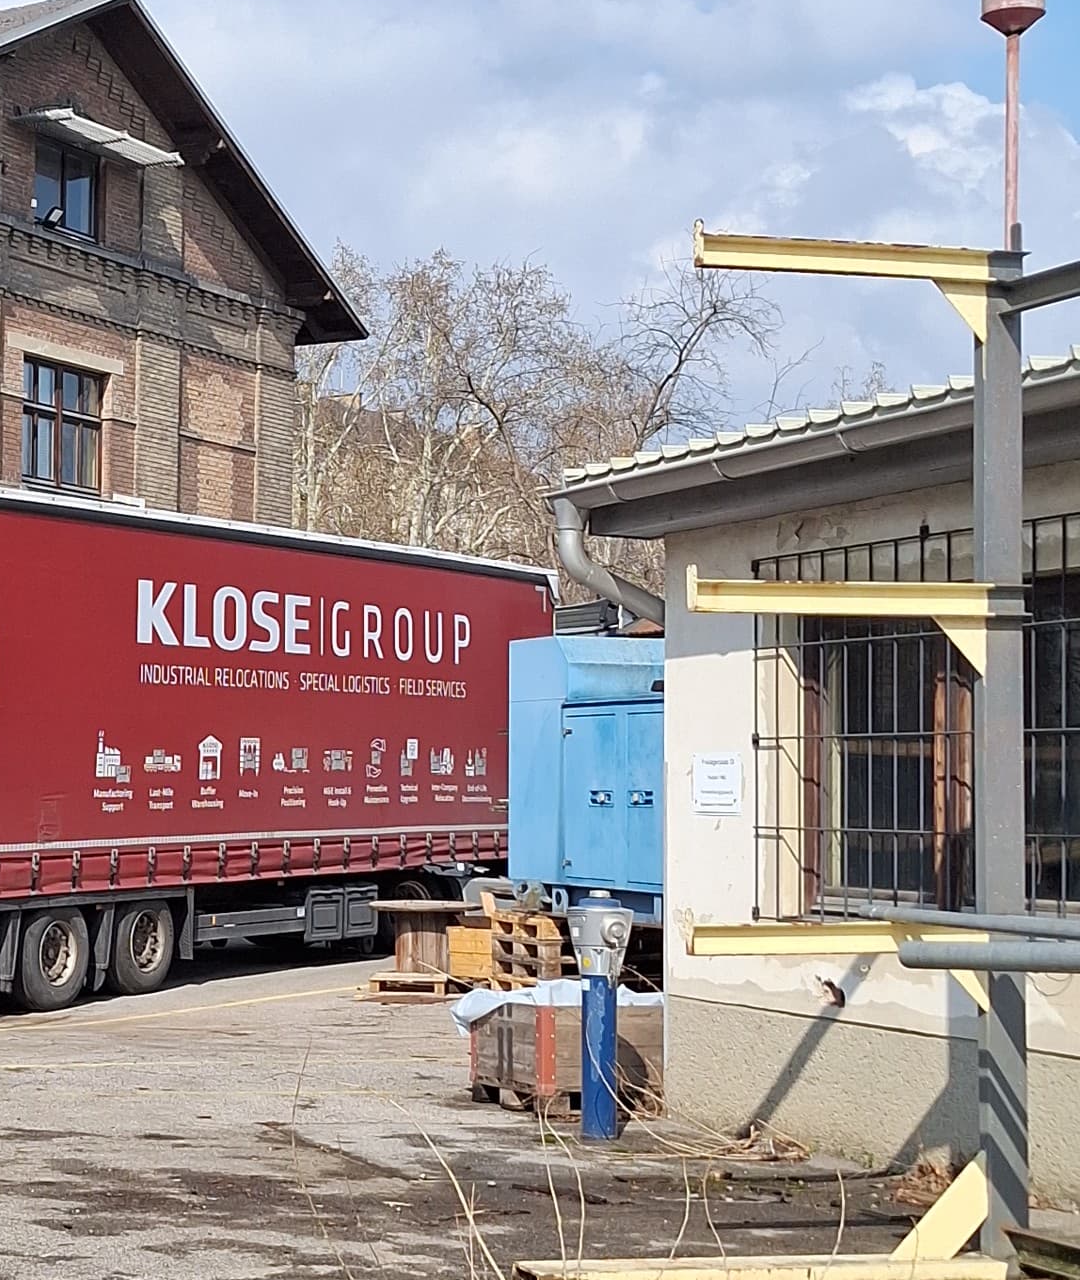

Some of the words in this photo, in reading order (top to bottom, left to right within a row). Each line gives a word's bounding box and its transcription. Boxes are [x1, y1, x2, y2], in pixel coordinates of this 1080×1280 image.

[136, 579, 311, 655] KLOSE
[331, 600, 471, 665] GROUP
[140, 663, 211, 686] INDUSTRIAL
[214, 668, 289, 690] RELOCATIONS
[300, 672, 340, 692] SPECIAL
[343, 675, 390, 695] LOGISTICS
[399, 678, 423, 696] FIELD
[426, 679, 467, 699] SERVICES
[93, 788, 133, 800] Manufacturing
